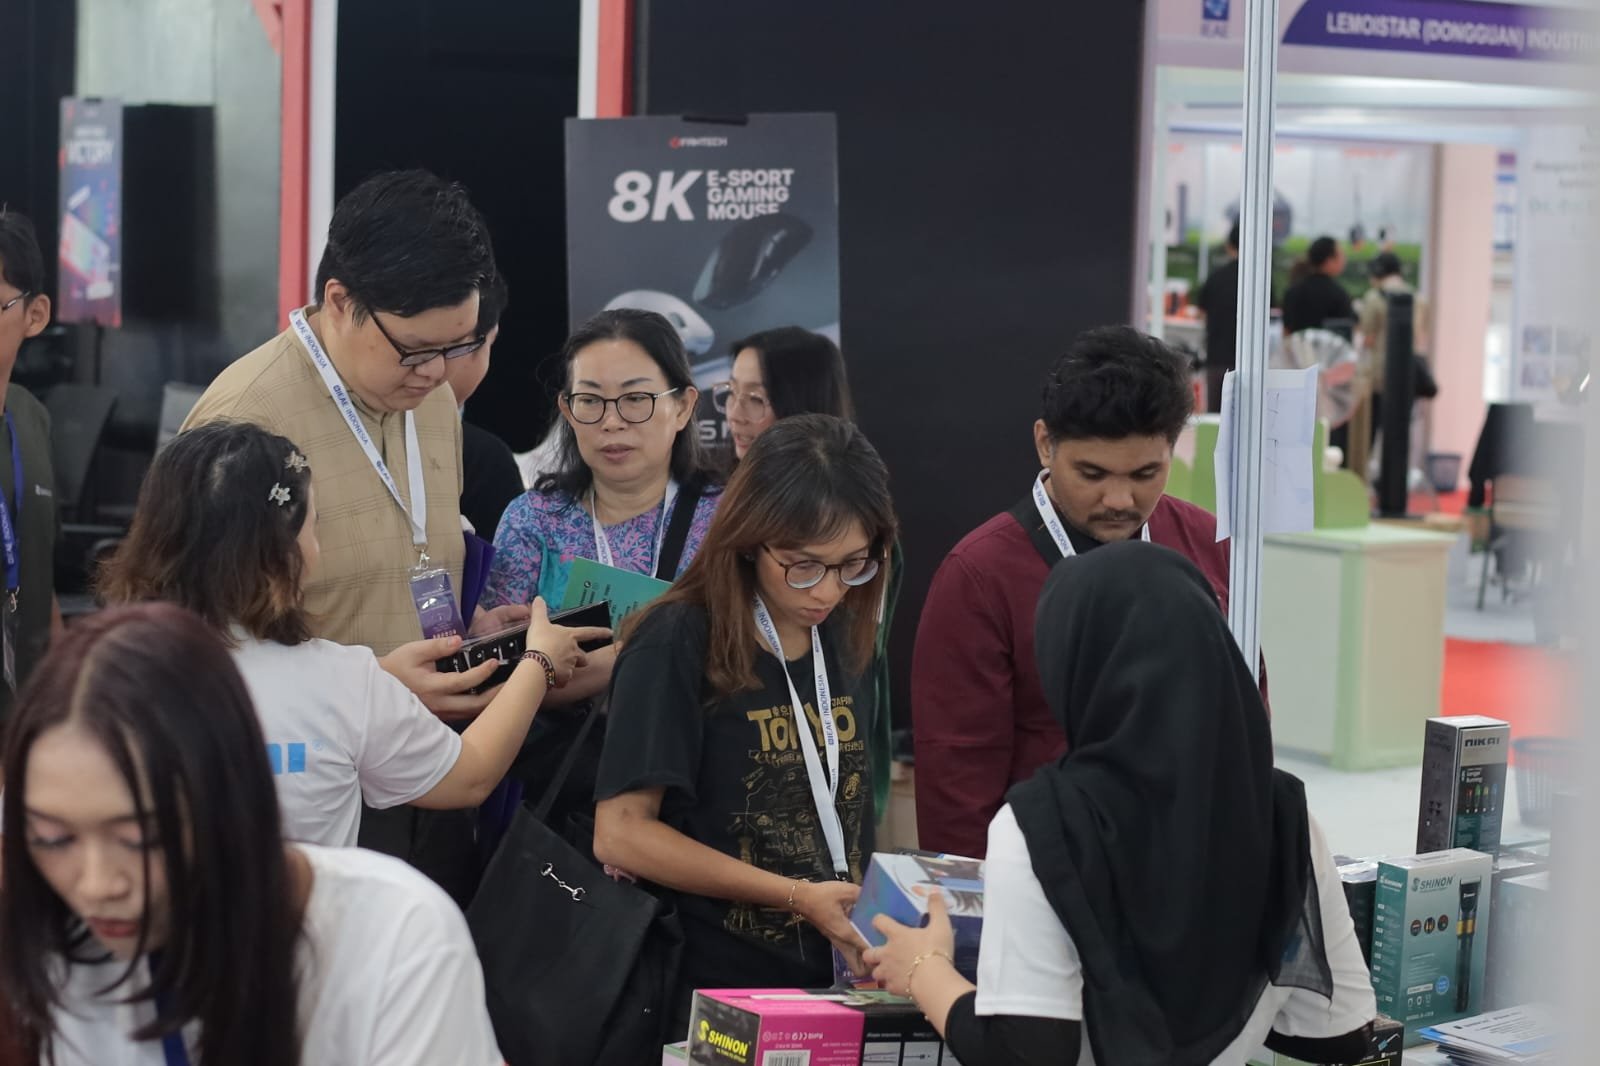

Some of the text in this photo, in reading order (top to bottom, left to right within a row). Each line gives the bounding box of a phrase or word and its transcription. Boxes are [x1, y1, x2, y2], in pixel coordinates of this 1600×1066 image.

[1326, 11, 1421, 40] LEMOISTAR
[1423, 18, 1526, 51] (DONGGUAN)
[706, 169, 795, 188] E-SPORT
[706, 186, 790, 204] GAMING
[607, 170, 703, 223] 8K
[706, 203, 780, 221] MOUSE
[346, 407, 369, 445] INDONESIA
[757, 611, 780, 653] INDONESIA
[815, 674, 835, 740] IEAE INDONESIA
[1420, 875, 1454, 890] SHINON
[707, 1029, 749, 1057] SHINON
